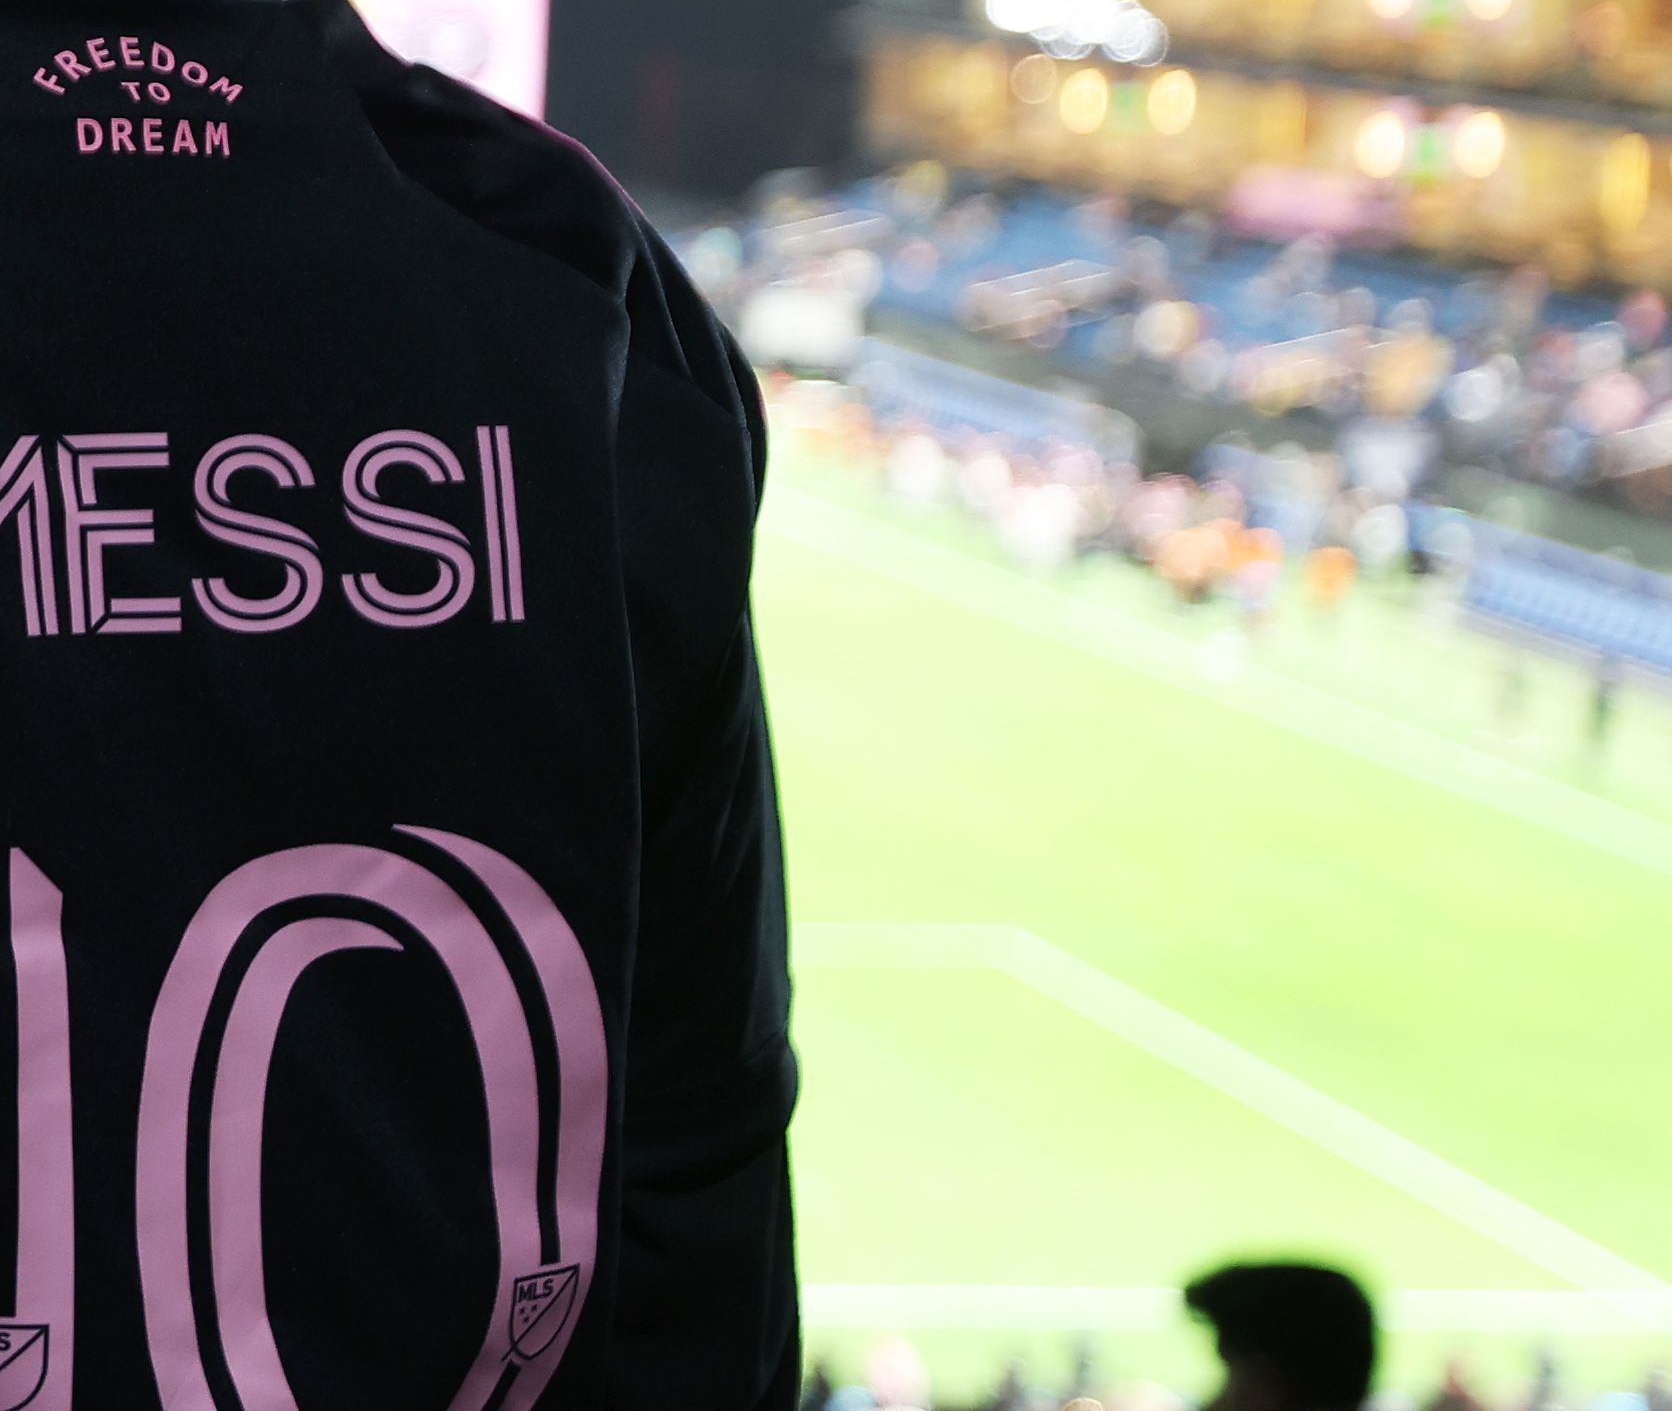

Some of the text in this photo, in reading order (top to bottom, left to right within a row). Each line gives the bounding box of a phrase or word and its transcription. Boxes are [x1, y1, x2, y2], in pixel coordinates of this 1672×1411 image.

[32, 36, 244, 104] FREEDOM
[120, 81, 172, 104] TO
[76, 117, 231, 157] DREAM
[517, 1278, 554, 1303] MLS
